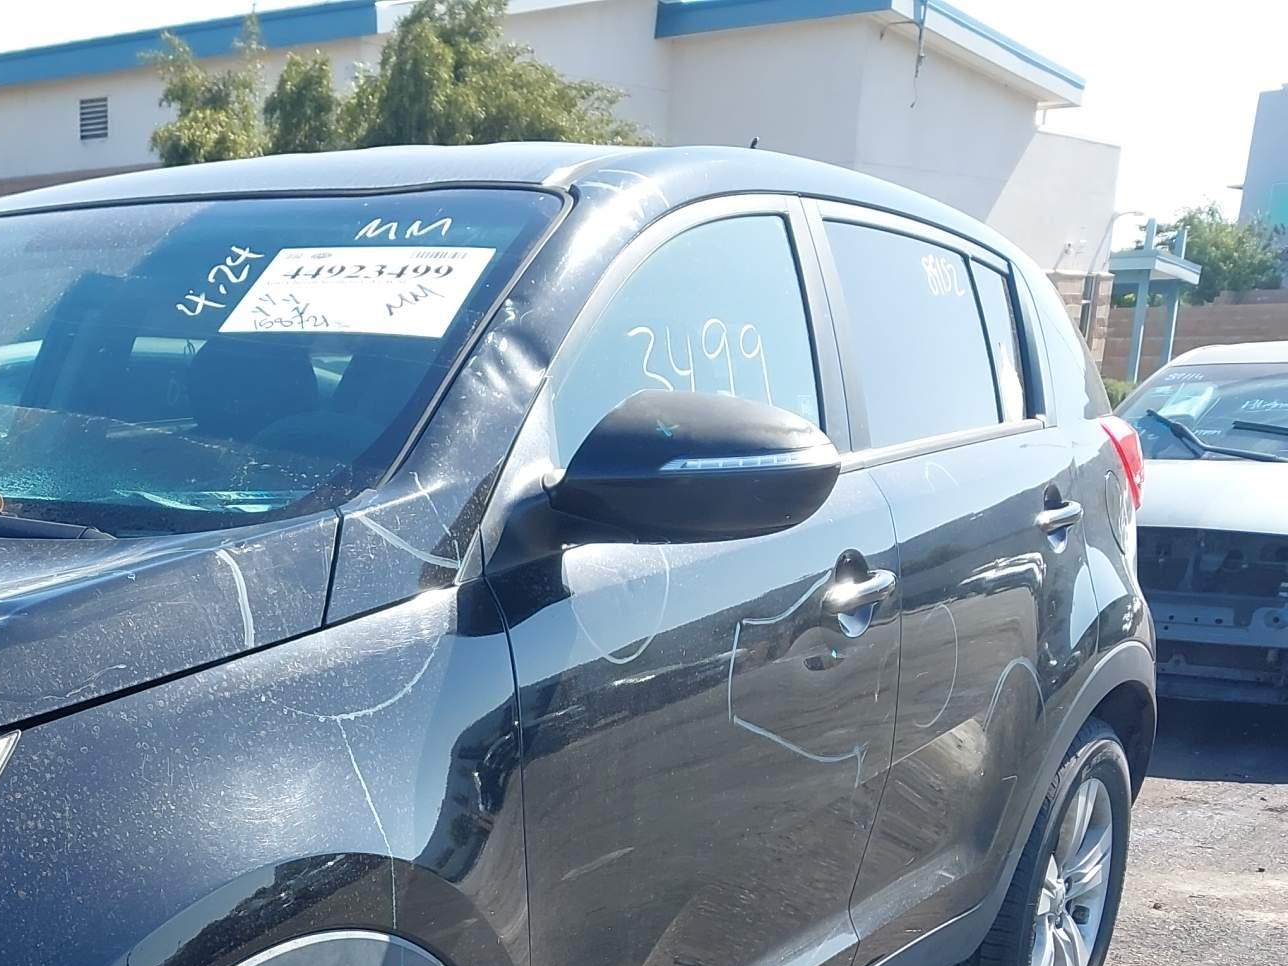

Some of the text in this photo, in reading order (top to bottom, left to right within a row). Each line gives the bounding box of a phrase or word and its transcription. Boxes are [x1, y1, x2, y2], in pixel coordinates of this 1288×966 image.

[175, 245, 265, 316] 4.24
[282, 265, 454, 280] 44923499
[627, 318, 774, 407] 3499
